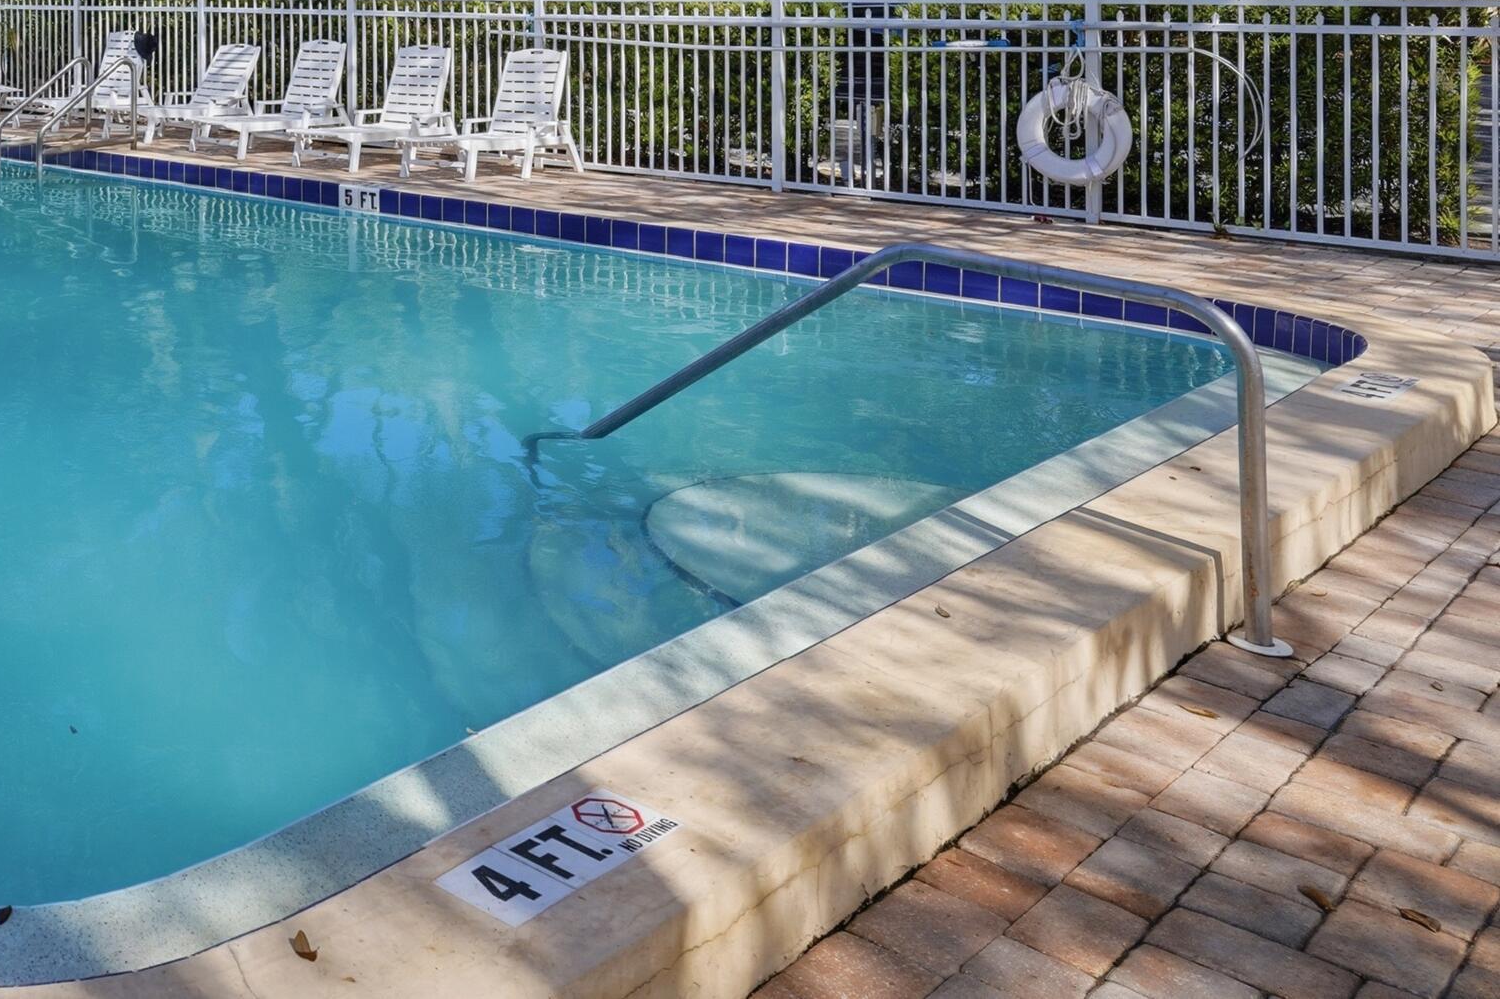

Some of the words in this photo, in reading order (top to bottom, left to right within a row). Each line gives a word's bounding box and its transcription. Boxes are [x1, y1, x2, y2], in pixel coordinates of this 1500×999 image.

[345, 189, 353, 206] 5
[360, 191, 378, 210] FT.
[617, 835, 643, 853] NO
[639, 818, 679, 843] DIVING
[471, 864, 542, 902] 4
[509, 824, 614, 880] FT.
